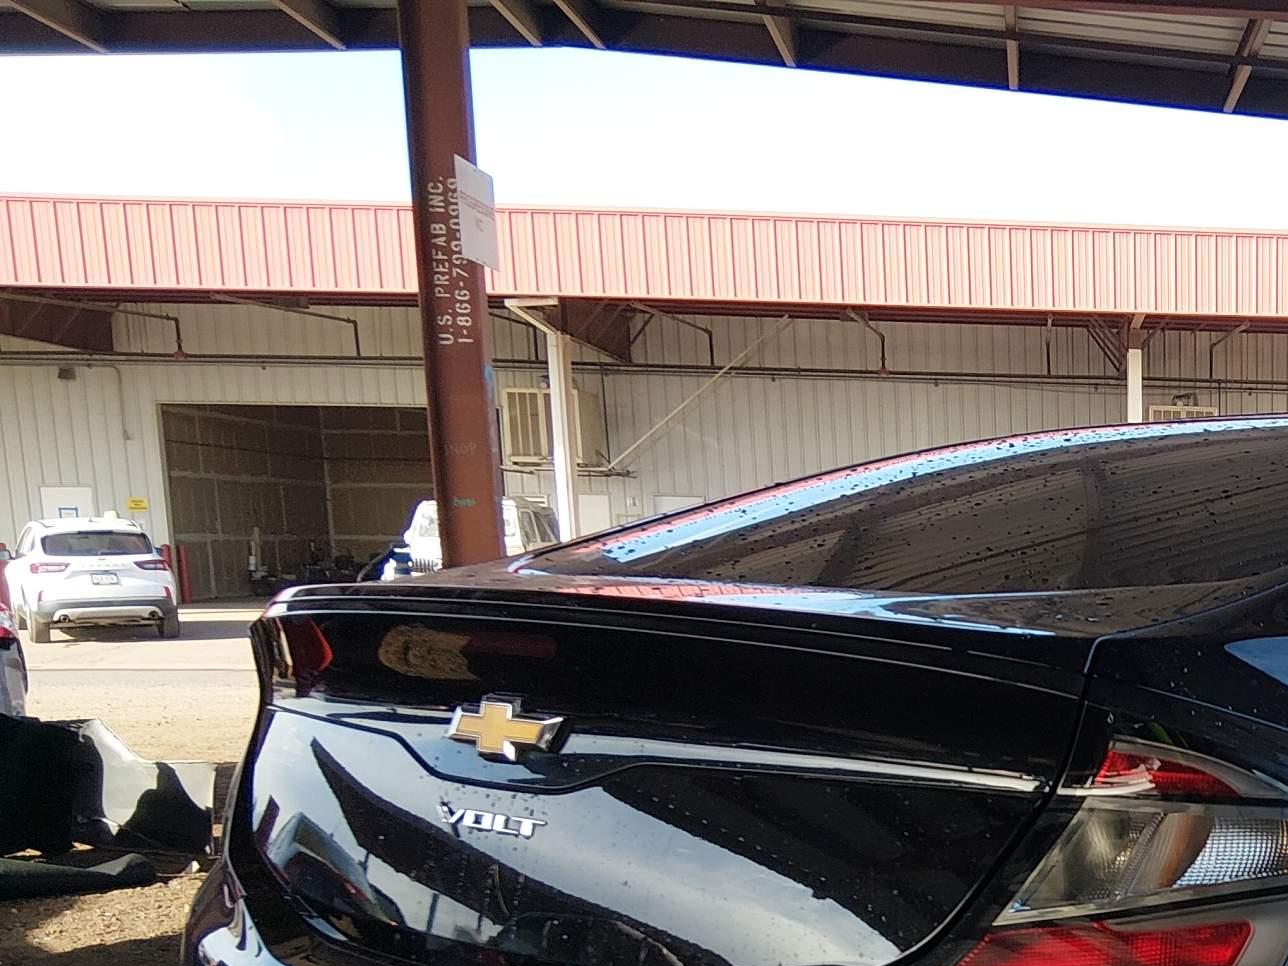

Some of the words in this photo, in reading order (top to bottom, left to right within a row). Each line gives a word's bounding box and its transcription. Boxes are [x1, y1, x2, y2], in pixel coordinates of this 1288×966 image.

[427, 175, 445, 213] INC.
[431, 223, 451, 297] PREFAB
[437, 309, 454, 345] U.S.
[436, 803, 548, 839] VOLT
